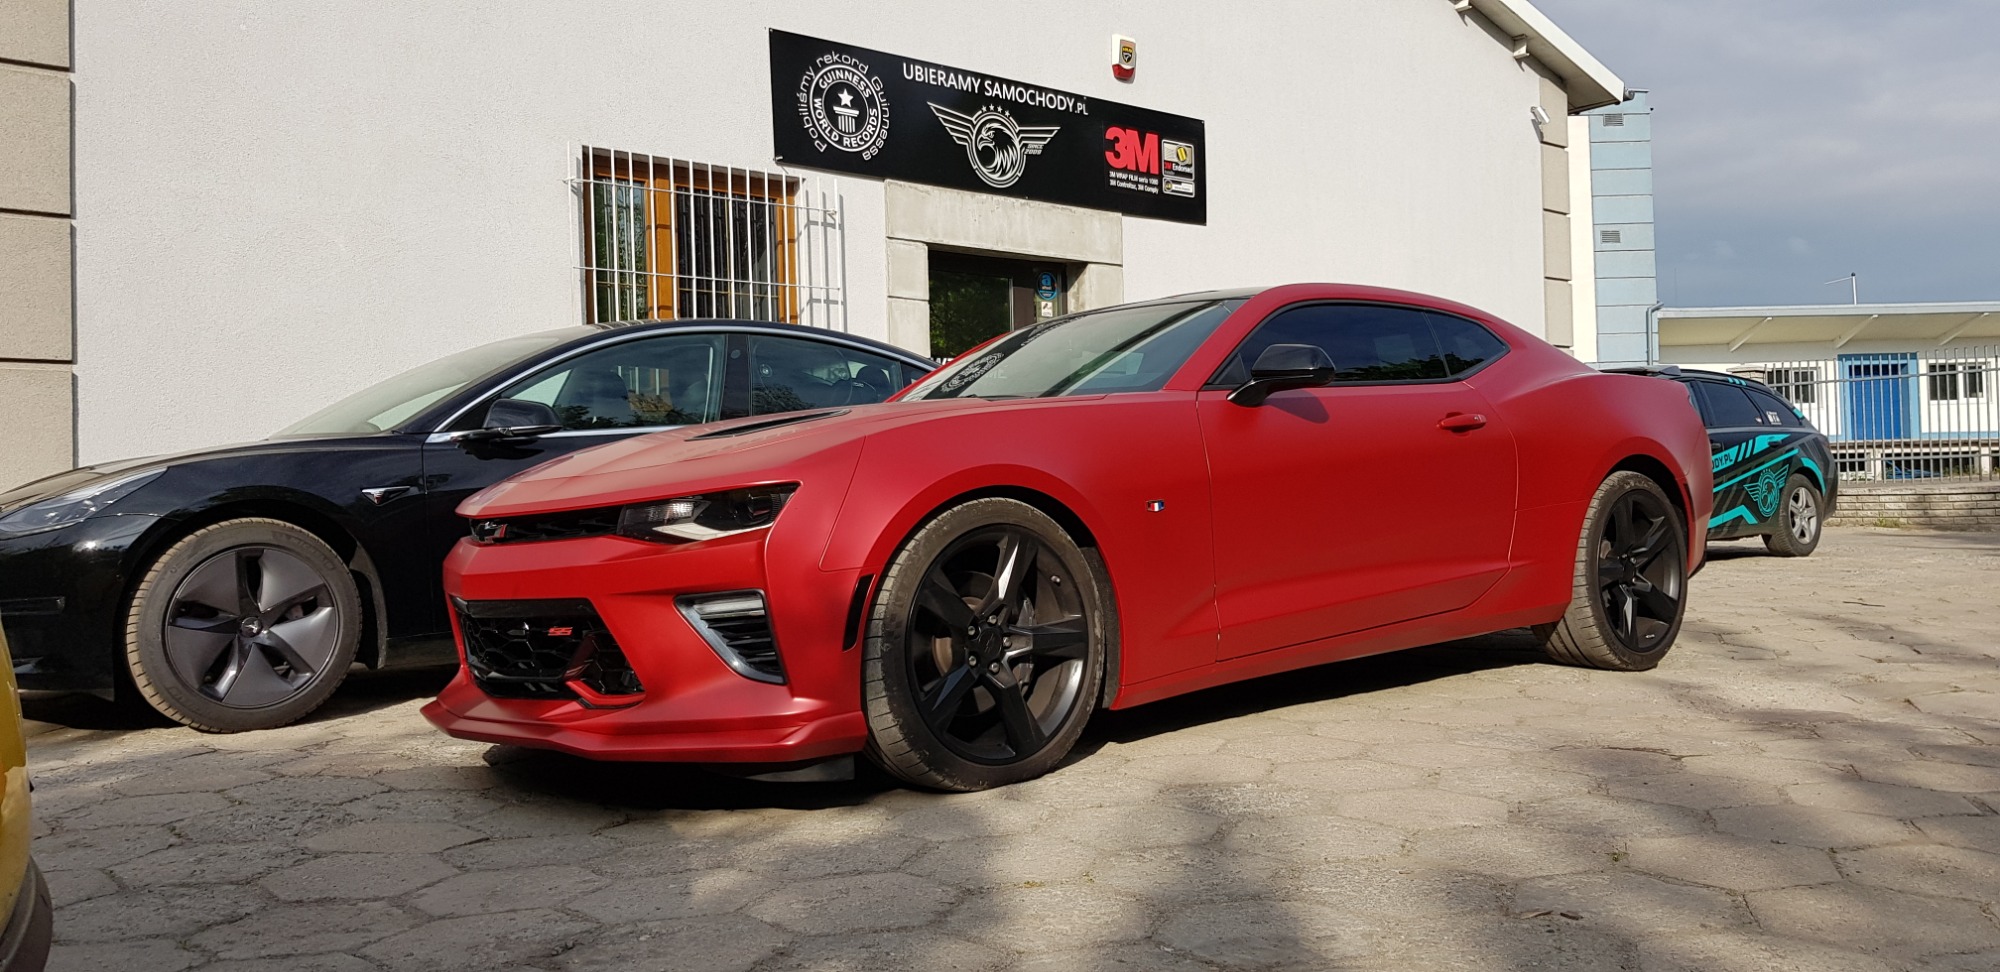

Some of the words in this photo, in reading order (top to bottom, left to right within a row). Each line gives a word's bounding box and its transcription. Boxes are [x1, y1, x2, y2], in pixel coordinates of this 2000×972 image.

[796, 66, 828, 152] Pobiliśmy
[816, 50, 869, 75] rekord
[819, 69, 872, 98] GUINNESS
[902, 62, 981, 94] UBIERAMY
[984, 80, 1089, 116] SAMOCHODY.PL
[813, 98, 840, 142] WORLD
[843, 108, 878, 148] RECORDS
[1105, 126, 1159, 175] 3M
